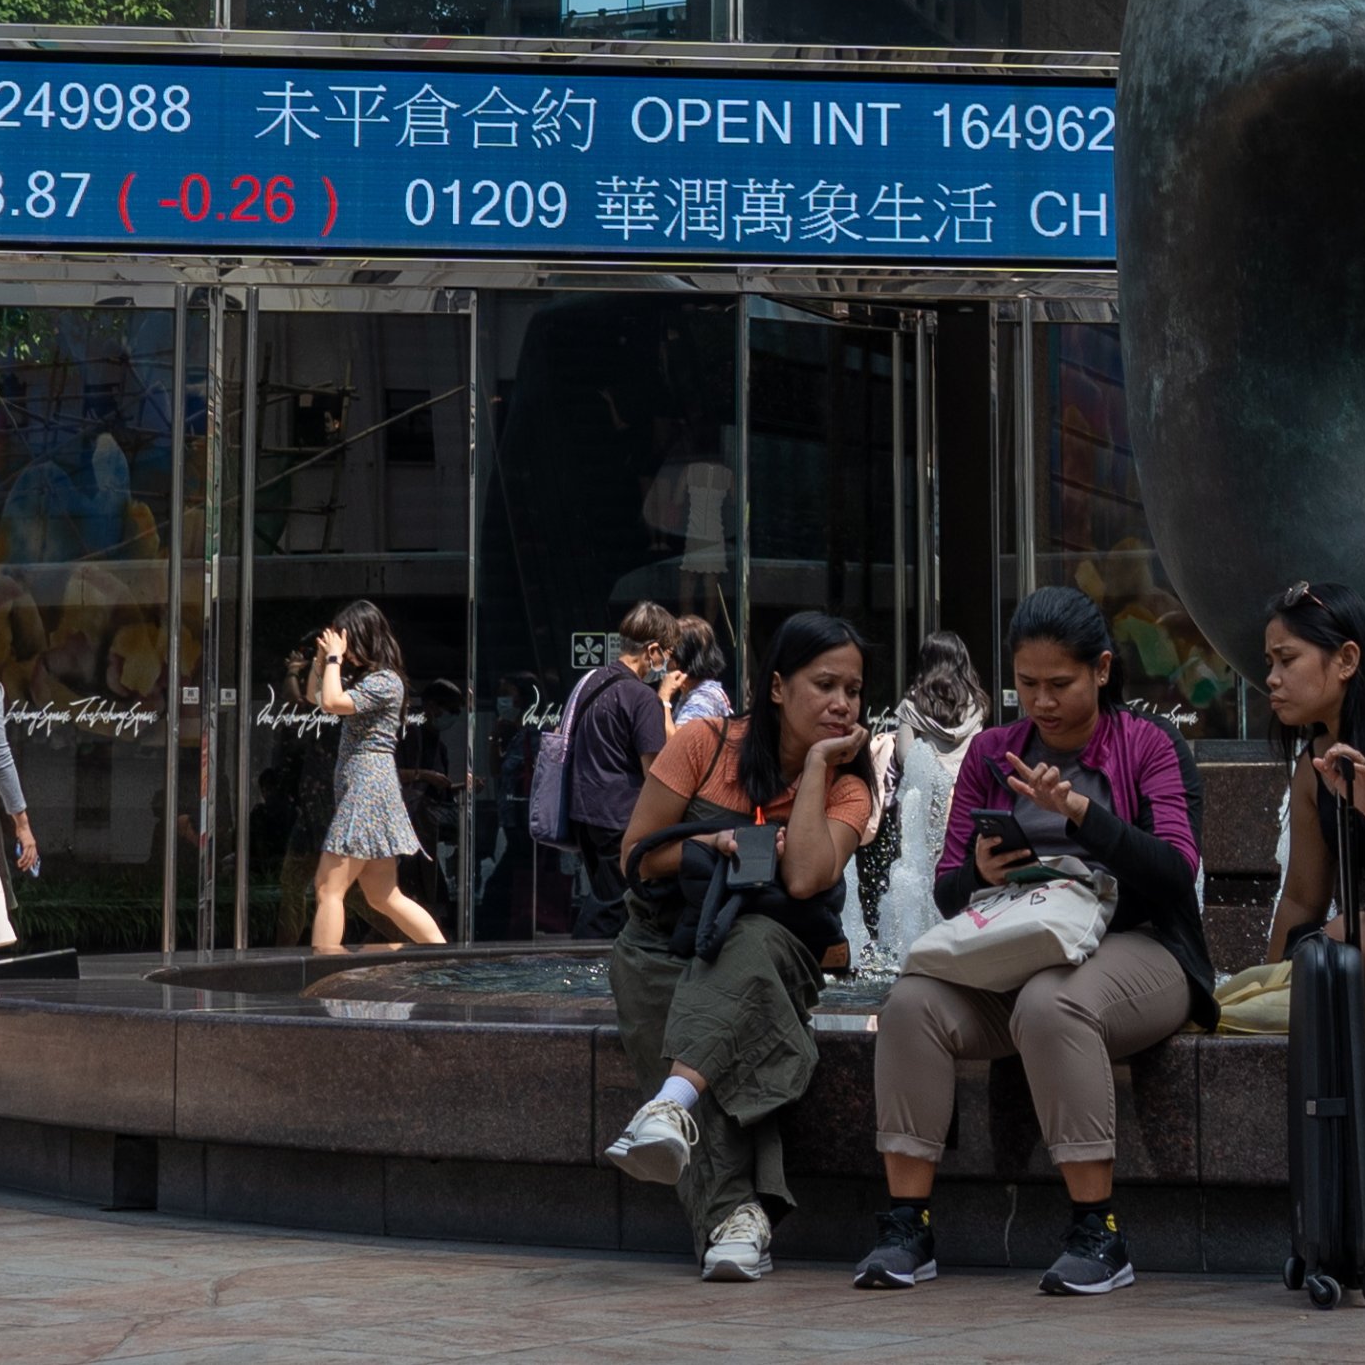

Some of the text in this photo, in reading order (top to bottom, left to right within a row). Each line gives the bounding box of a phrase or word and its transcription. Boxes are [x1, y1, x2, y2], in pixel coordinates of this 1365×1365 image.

[254, 80, 598, 154] 未平倉合約
[630, 95, 792, 147] OPEN
[814, 101, 901, 147] INT
[404, 180, 568, 229] 01209
[595, 176, 996, 244] 華潤萬象生活
